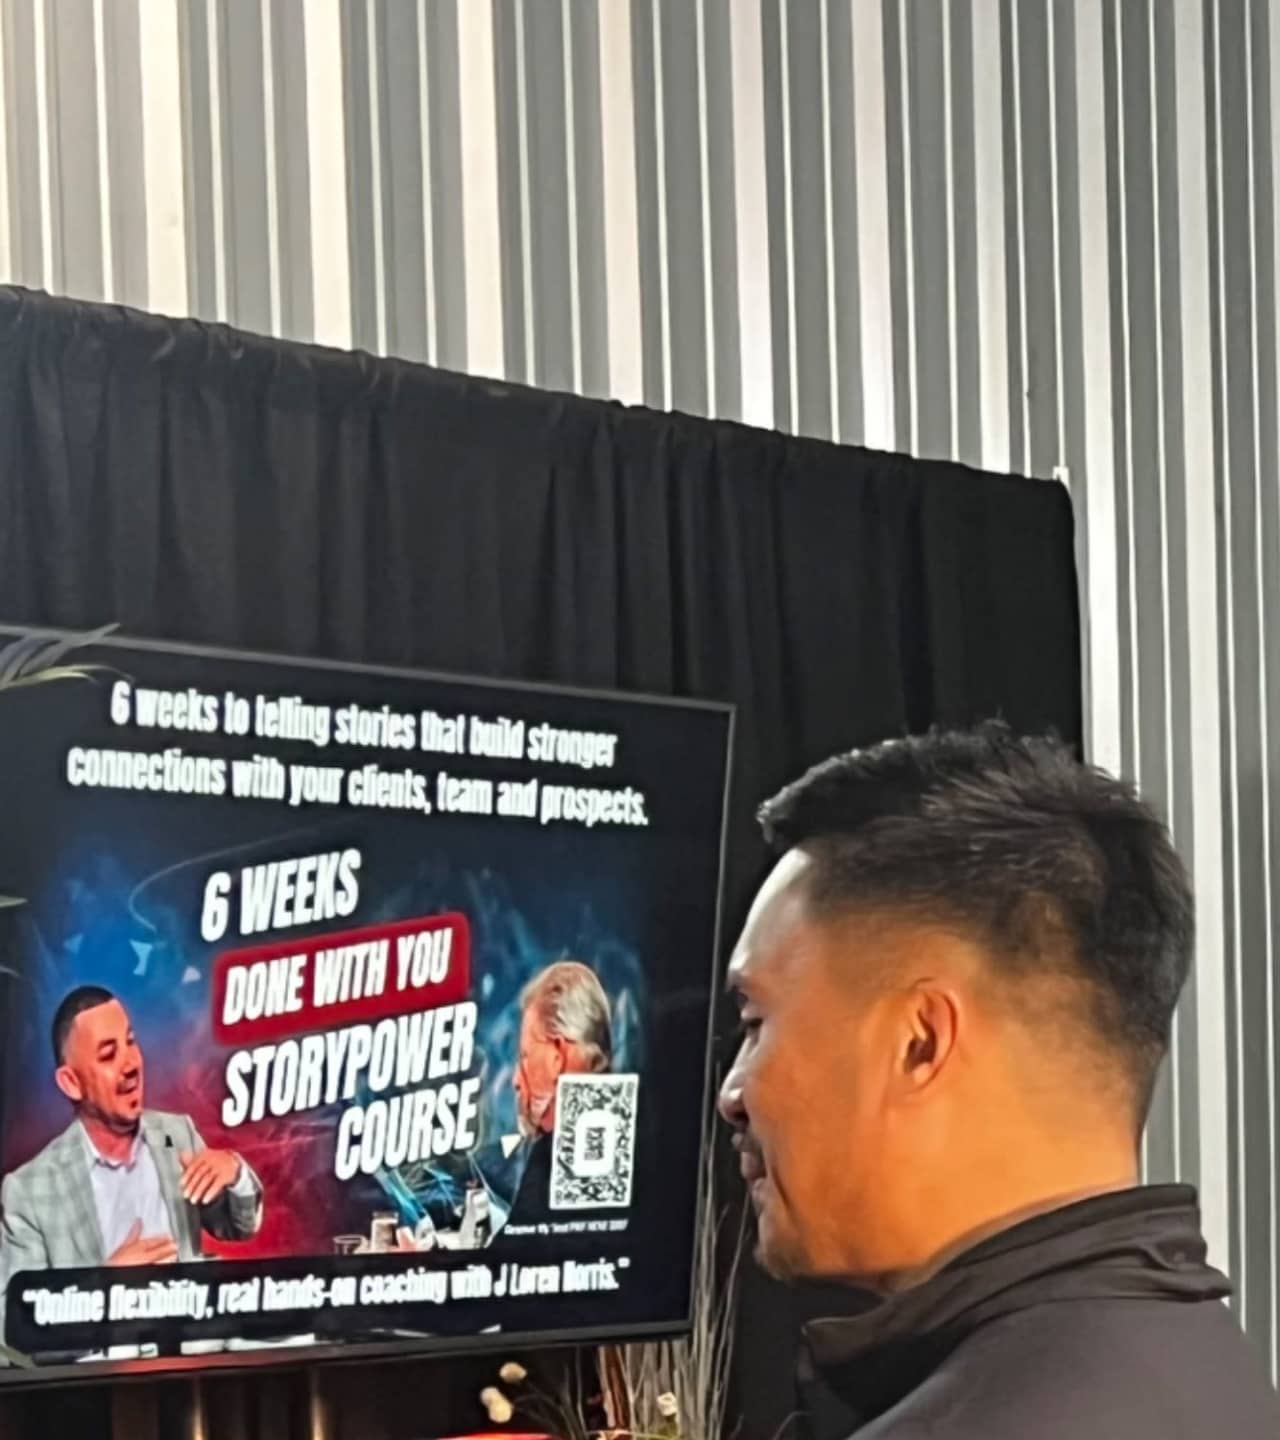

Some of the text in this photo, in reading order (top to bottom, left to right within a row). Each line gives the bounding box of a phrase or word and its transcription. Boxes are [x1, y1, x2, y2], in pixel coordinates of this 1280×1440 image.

[111, 680, 618, 769] 6 weeks to telling stories that build stronger
[67, 746, 648, 828] connections with your clients, team and prospects.
[201, 848, 361, 942] 6 WEEKS
[223, 927, 453, 1025] DONE WITH YOU
[221, 1001, 478, 1128] STORYPOWER
[335, 1077, 481, 1181] COURSE
[109, 1279, 214, 1319] flexibility,
[217, 1278, 260, 1313] real
[263, 1274, 356, 1310] hands-on
[360, 1267, 448, 1304] coaching
[451, 1265, 493, 1300] with
[494, 1263, 508, 1297] J
